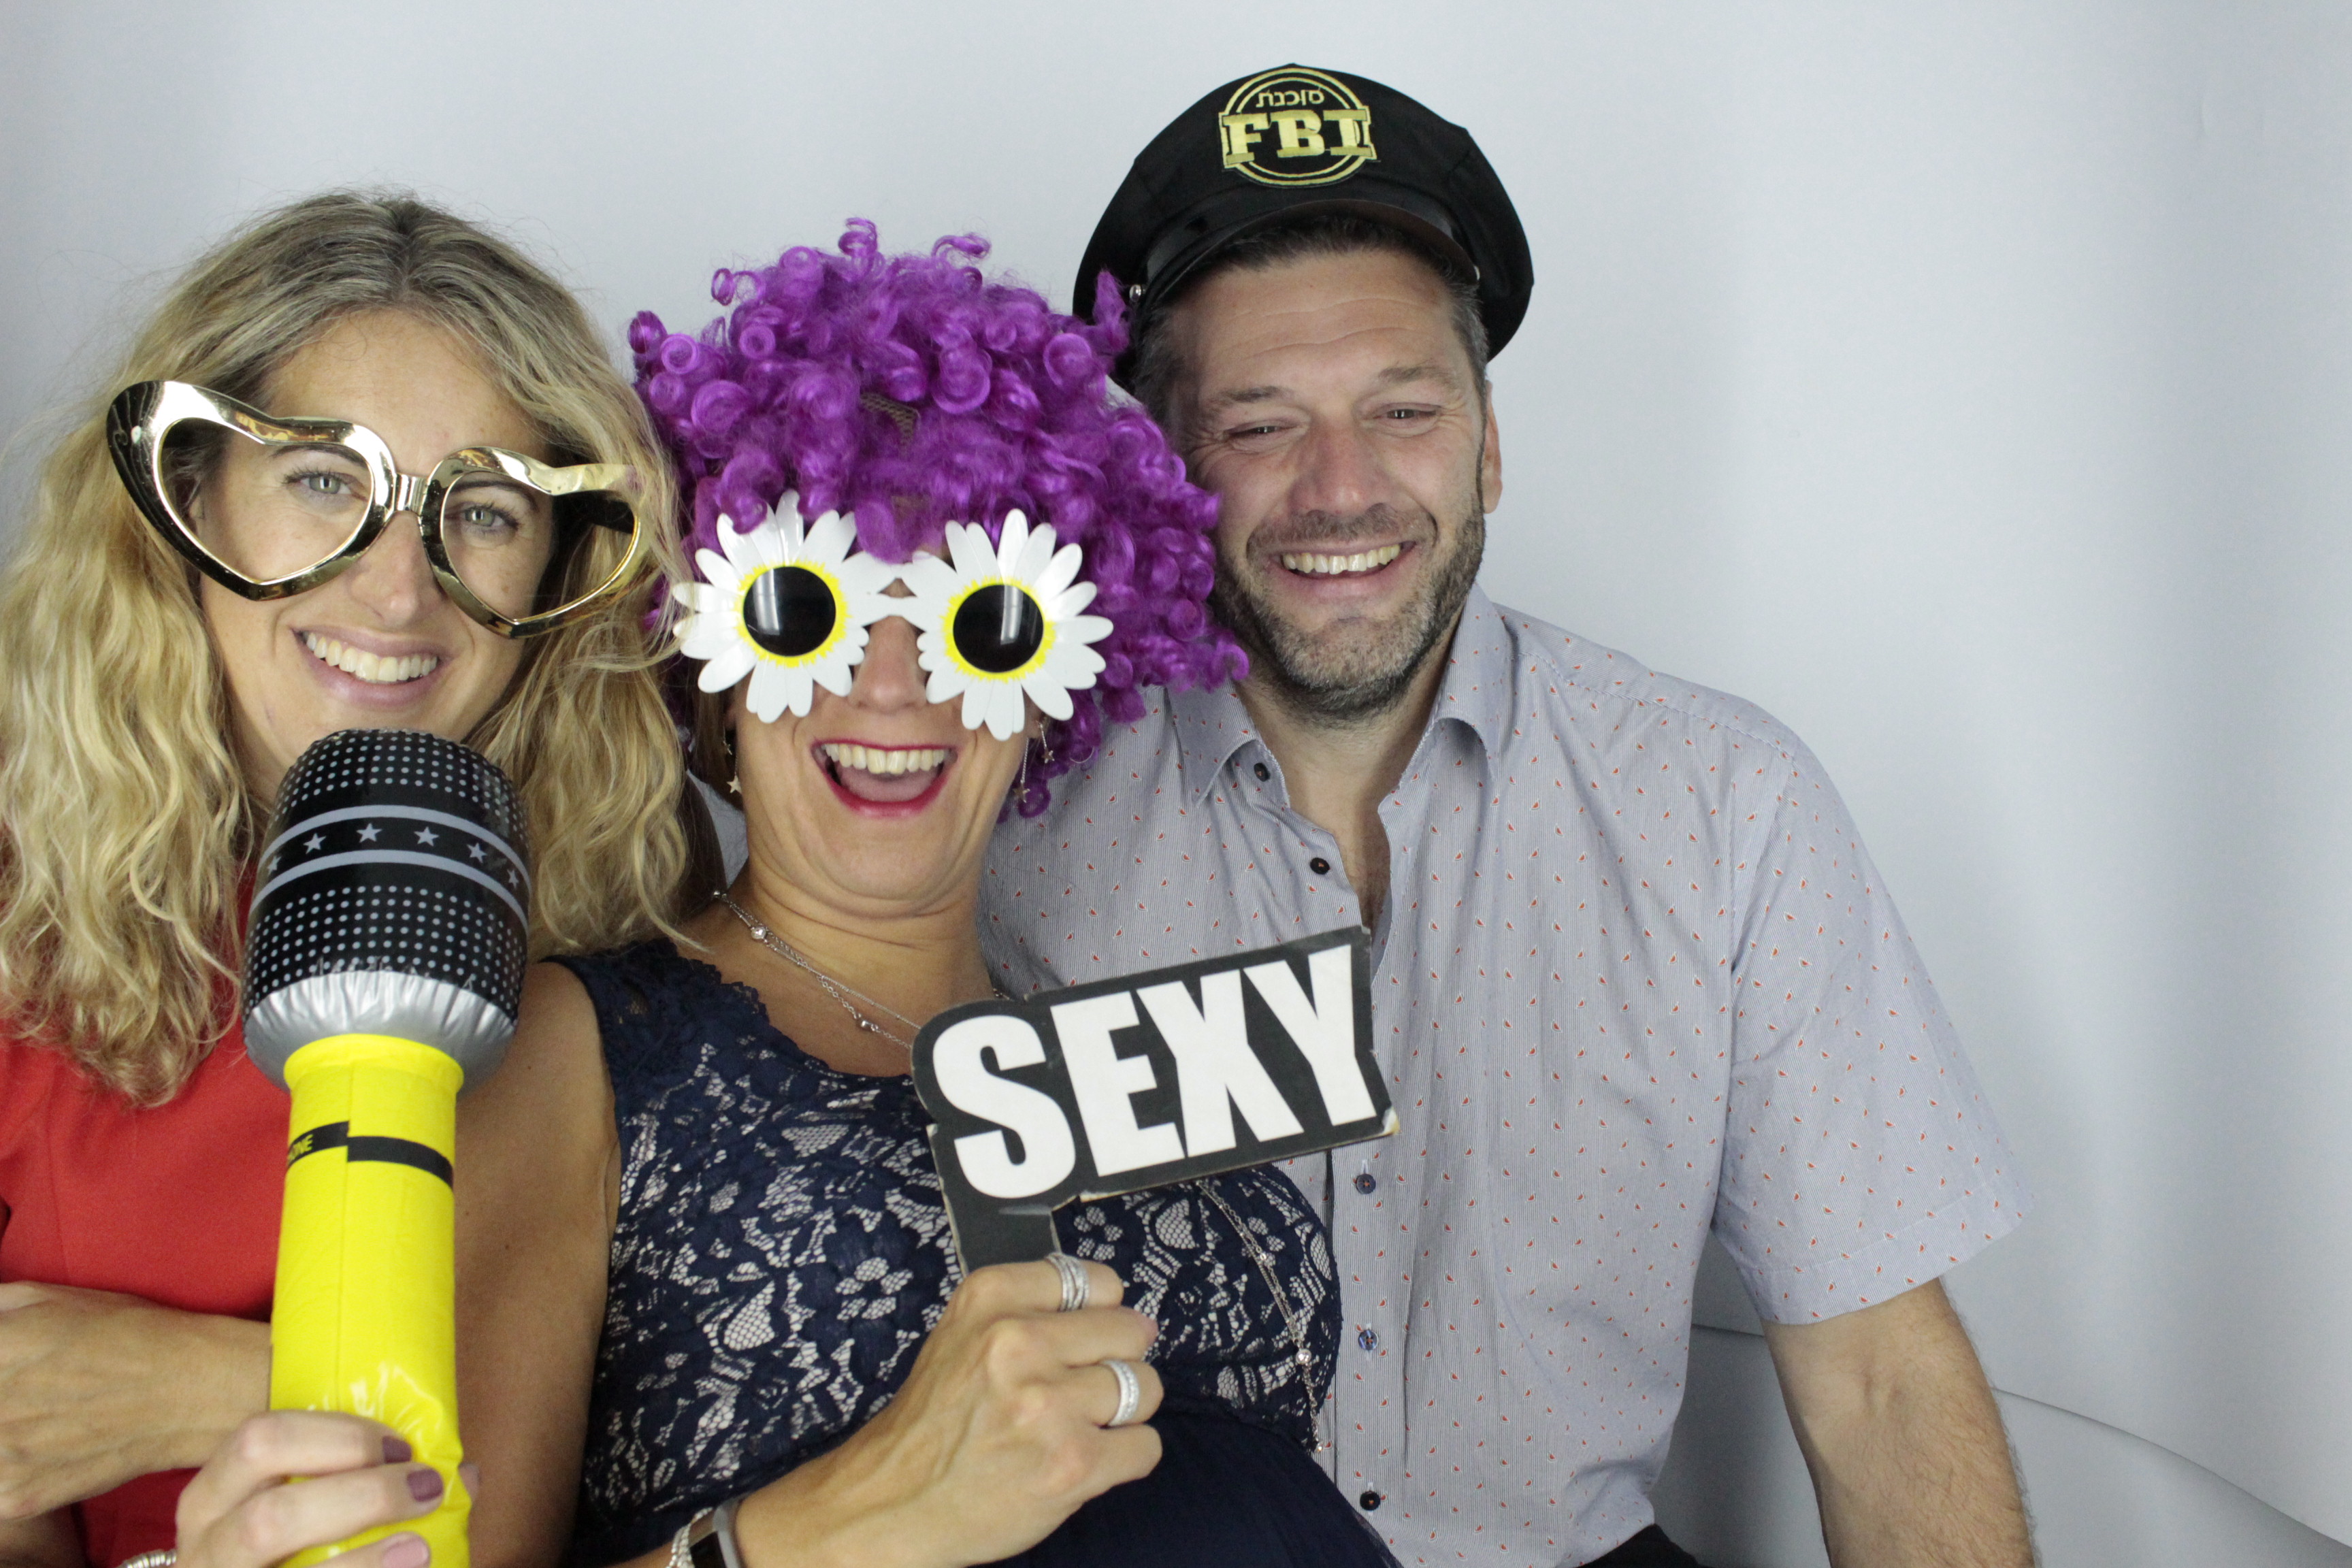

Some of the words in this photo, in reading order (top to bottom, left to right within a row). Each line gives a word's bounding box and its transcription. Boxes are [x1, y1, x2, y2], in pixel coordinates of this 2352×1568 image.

[1256, 89, 1324, 108] סוכנת
[1222, 110, 1373, 165] FBI
[932, 945, 1377, 1198] SEXY
